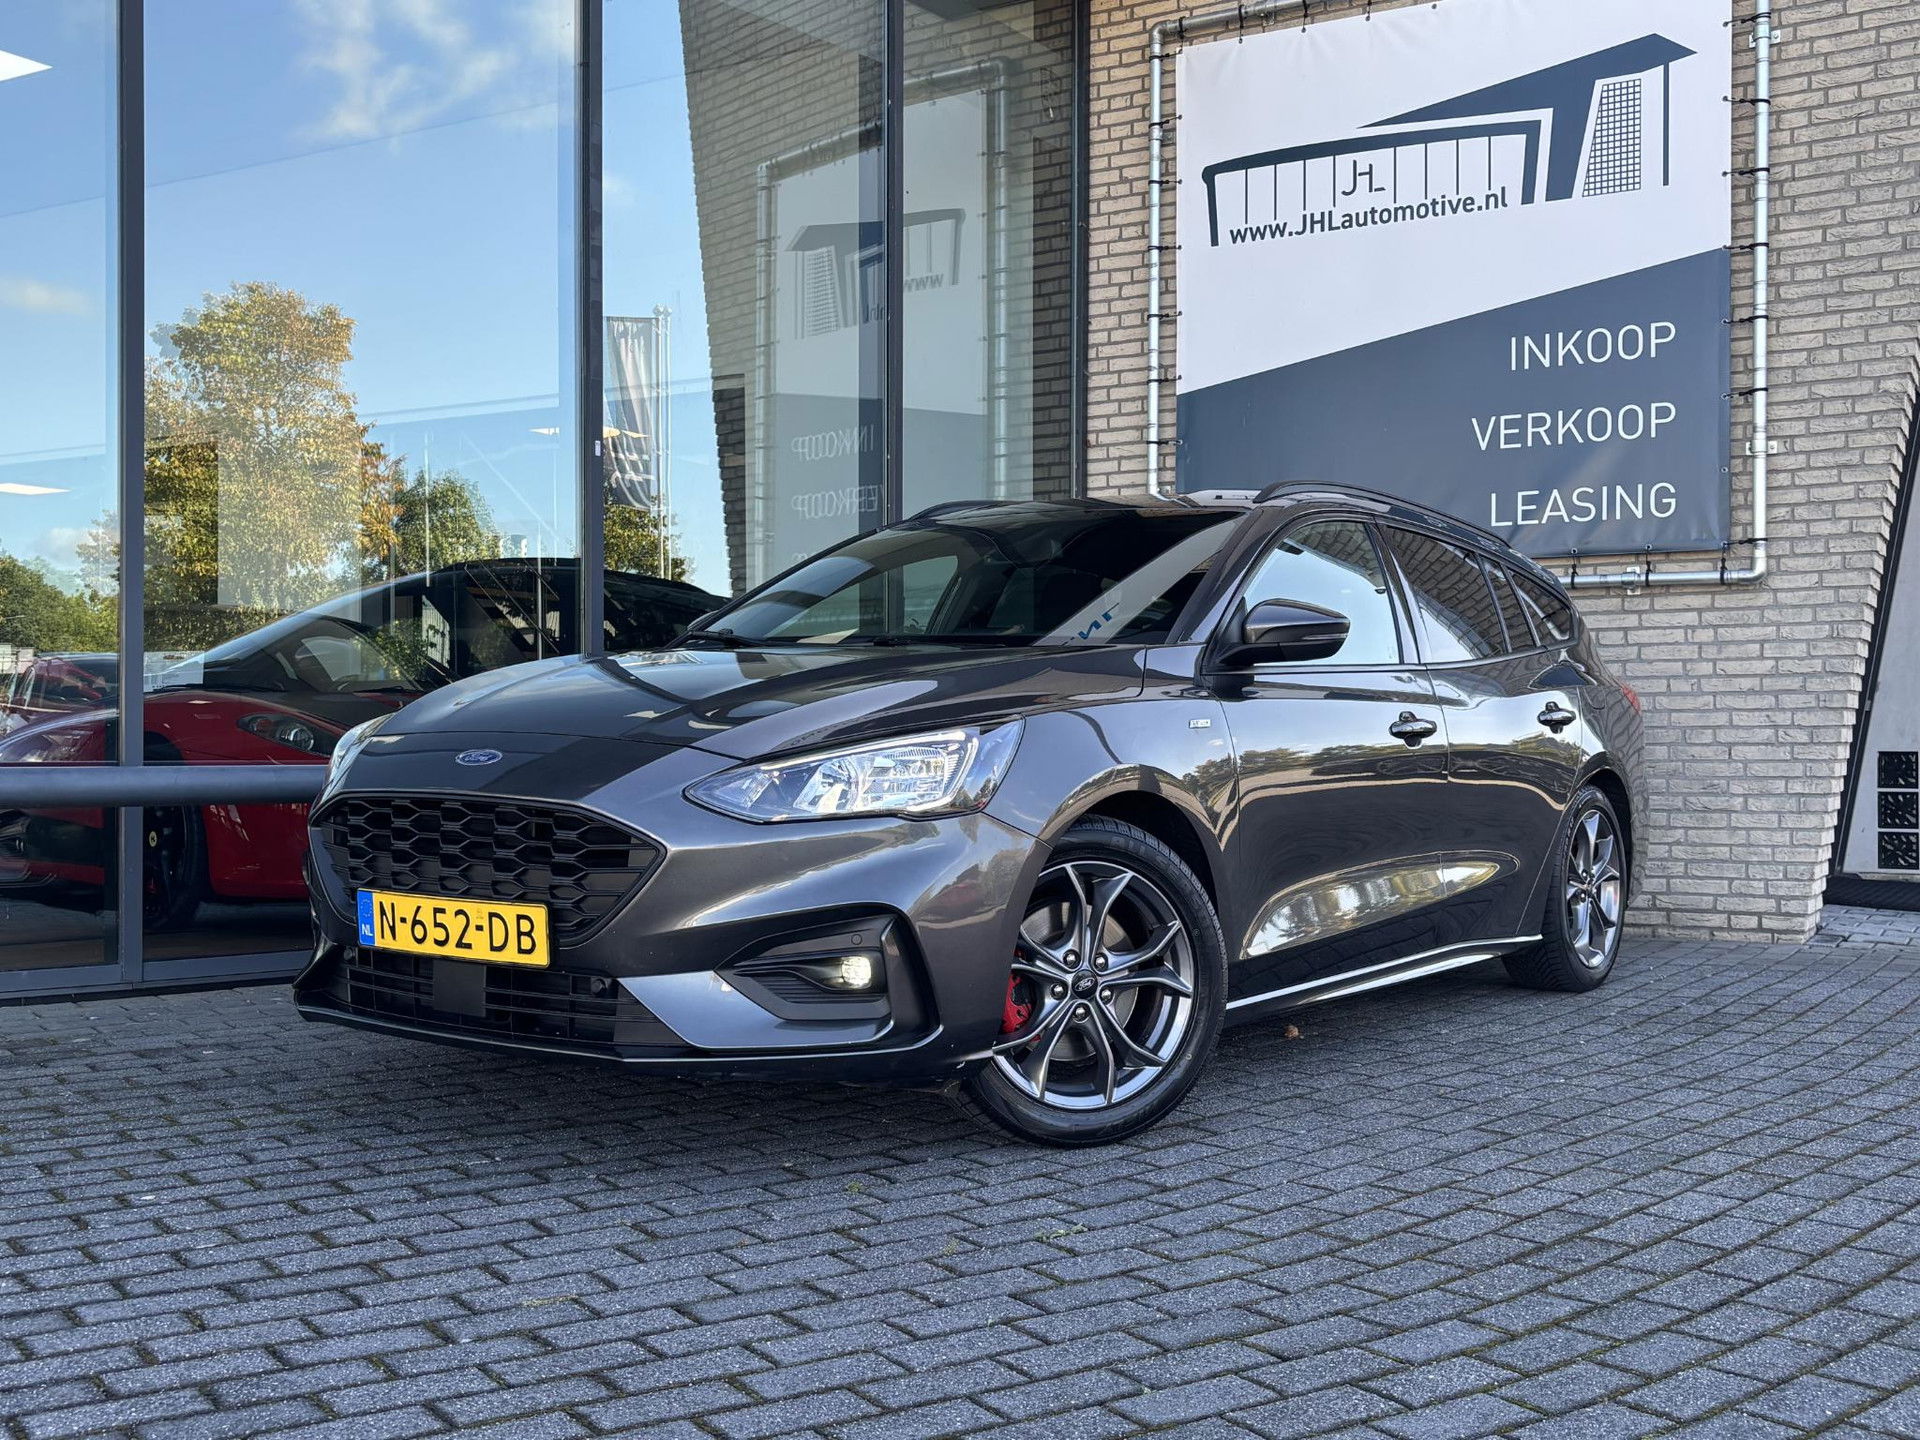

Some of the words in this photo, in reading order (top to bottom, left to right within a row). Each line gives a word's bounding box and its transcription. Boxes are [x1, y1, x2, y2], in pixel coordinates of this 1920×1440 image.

[1229, 186, 1508, 244] www.JHLautomotive.nl
[1511, 321, 1676, 371] INKOOP
[1471, 402, 1677, 451] VERKOOP
[1491, 482, 1677, 527] LEASING
[361, 923, 374, 937] NL
[379, 900, 537, 955] N-652-DB
